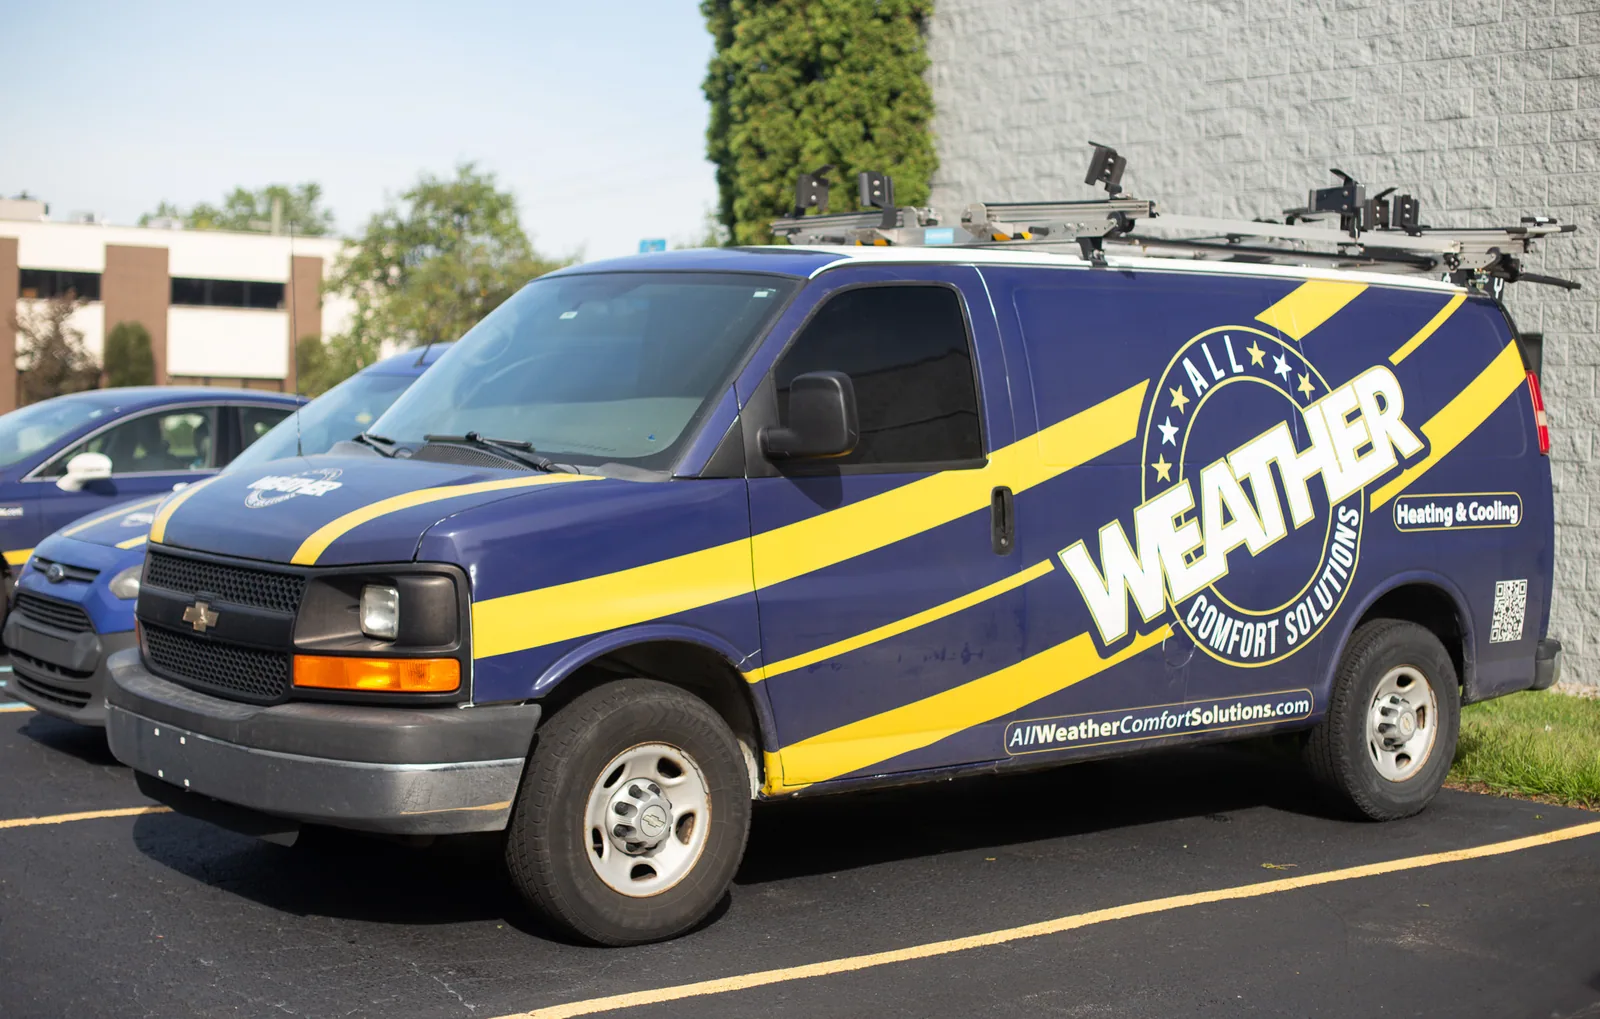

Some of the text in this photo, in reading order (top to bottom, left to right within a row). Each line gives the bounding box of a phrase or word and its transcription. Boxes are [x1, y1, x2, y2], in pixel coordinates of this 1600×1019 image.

[1183, 335, 1244, 397] ALL
[1057, 364, 1426, 645] WEATHER
[1397, 500, 1518, 527] Heating & Cooling
[1187, 505, 1360, 657] COMFORT SOLUTIONS
[1010, 698, 1308, 747] AllWeatherComfortSolutions.com
